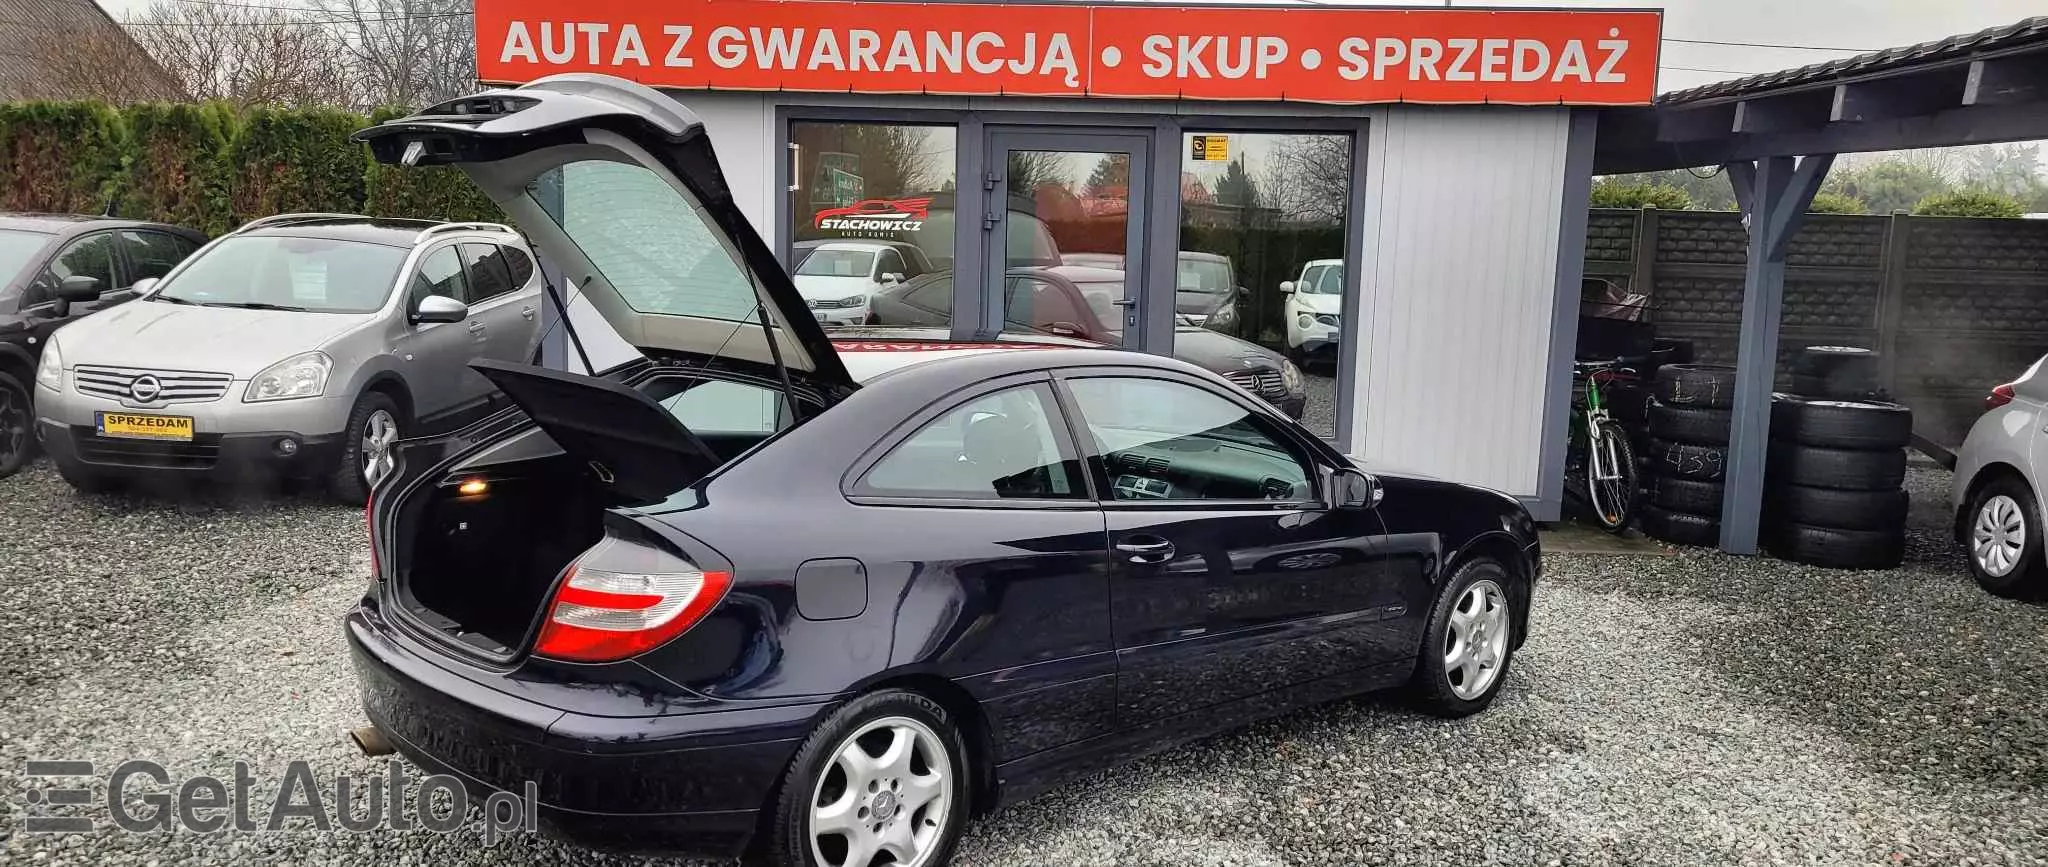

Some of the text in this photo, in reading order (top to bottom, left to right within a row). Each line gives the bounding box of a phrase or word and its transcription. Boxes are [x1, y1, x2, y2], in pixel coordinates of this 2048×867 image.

[500, 21, 1629, 88] AUTA Z GWARANCJĄ SKUP SPRZEDAŻ
[820, 218, 923, 231] STACHOWICZ
[108, 415, 188, 428] SPRZEDAM
